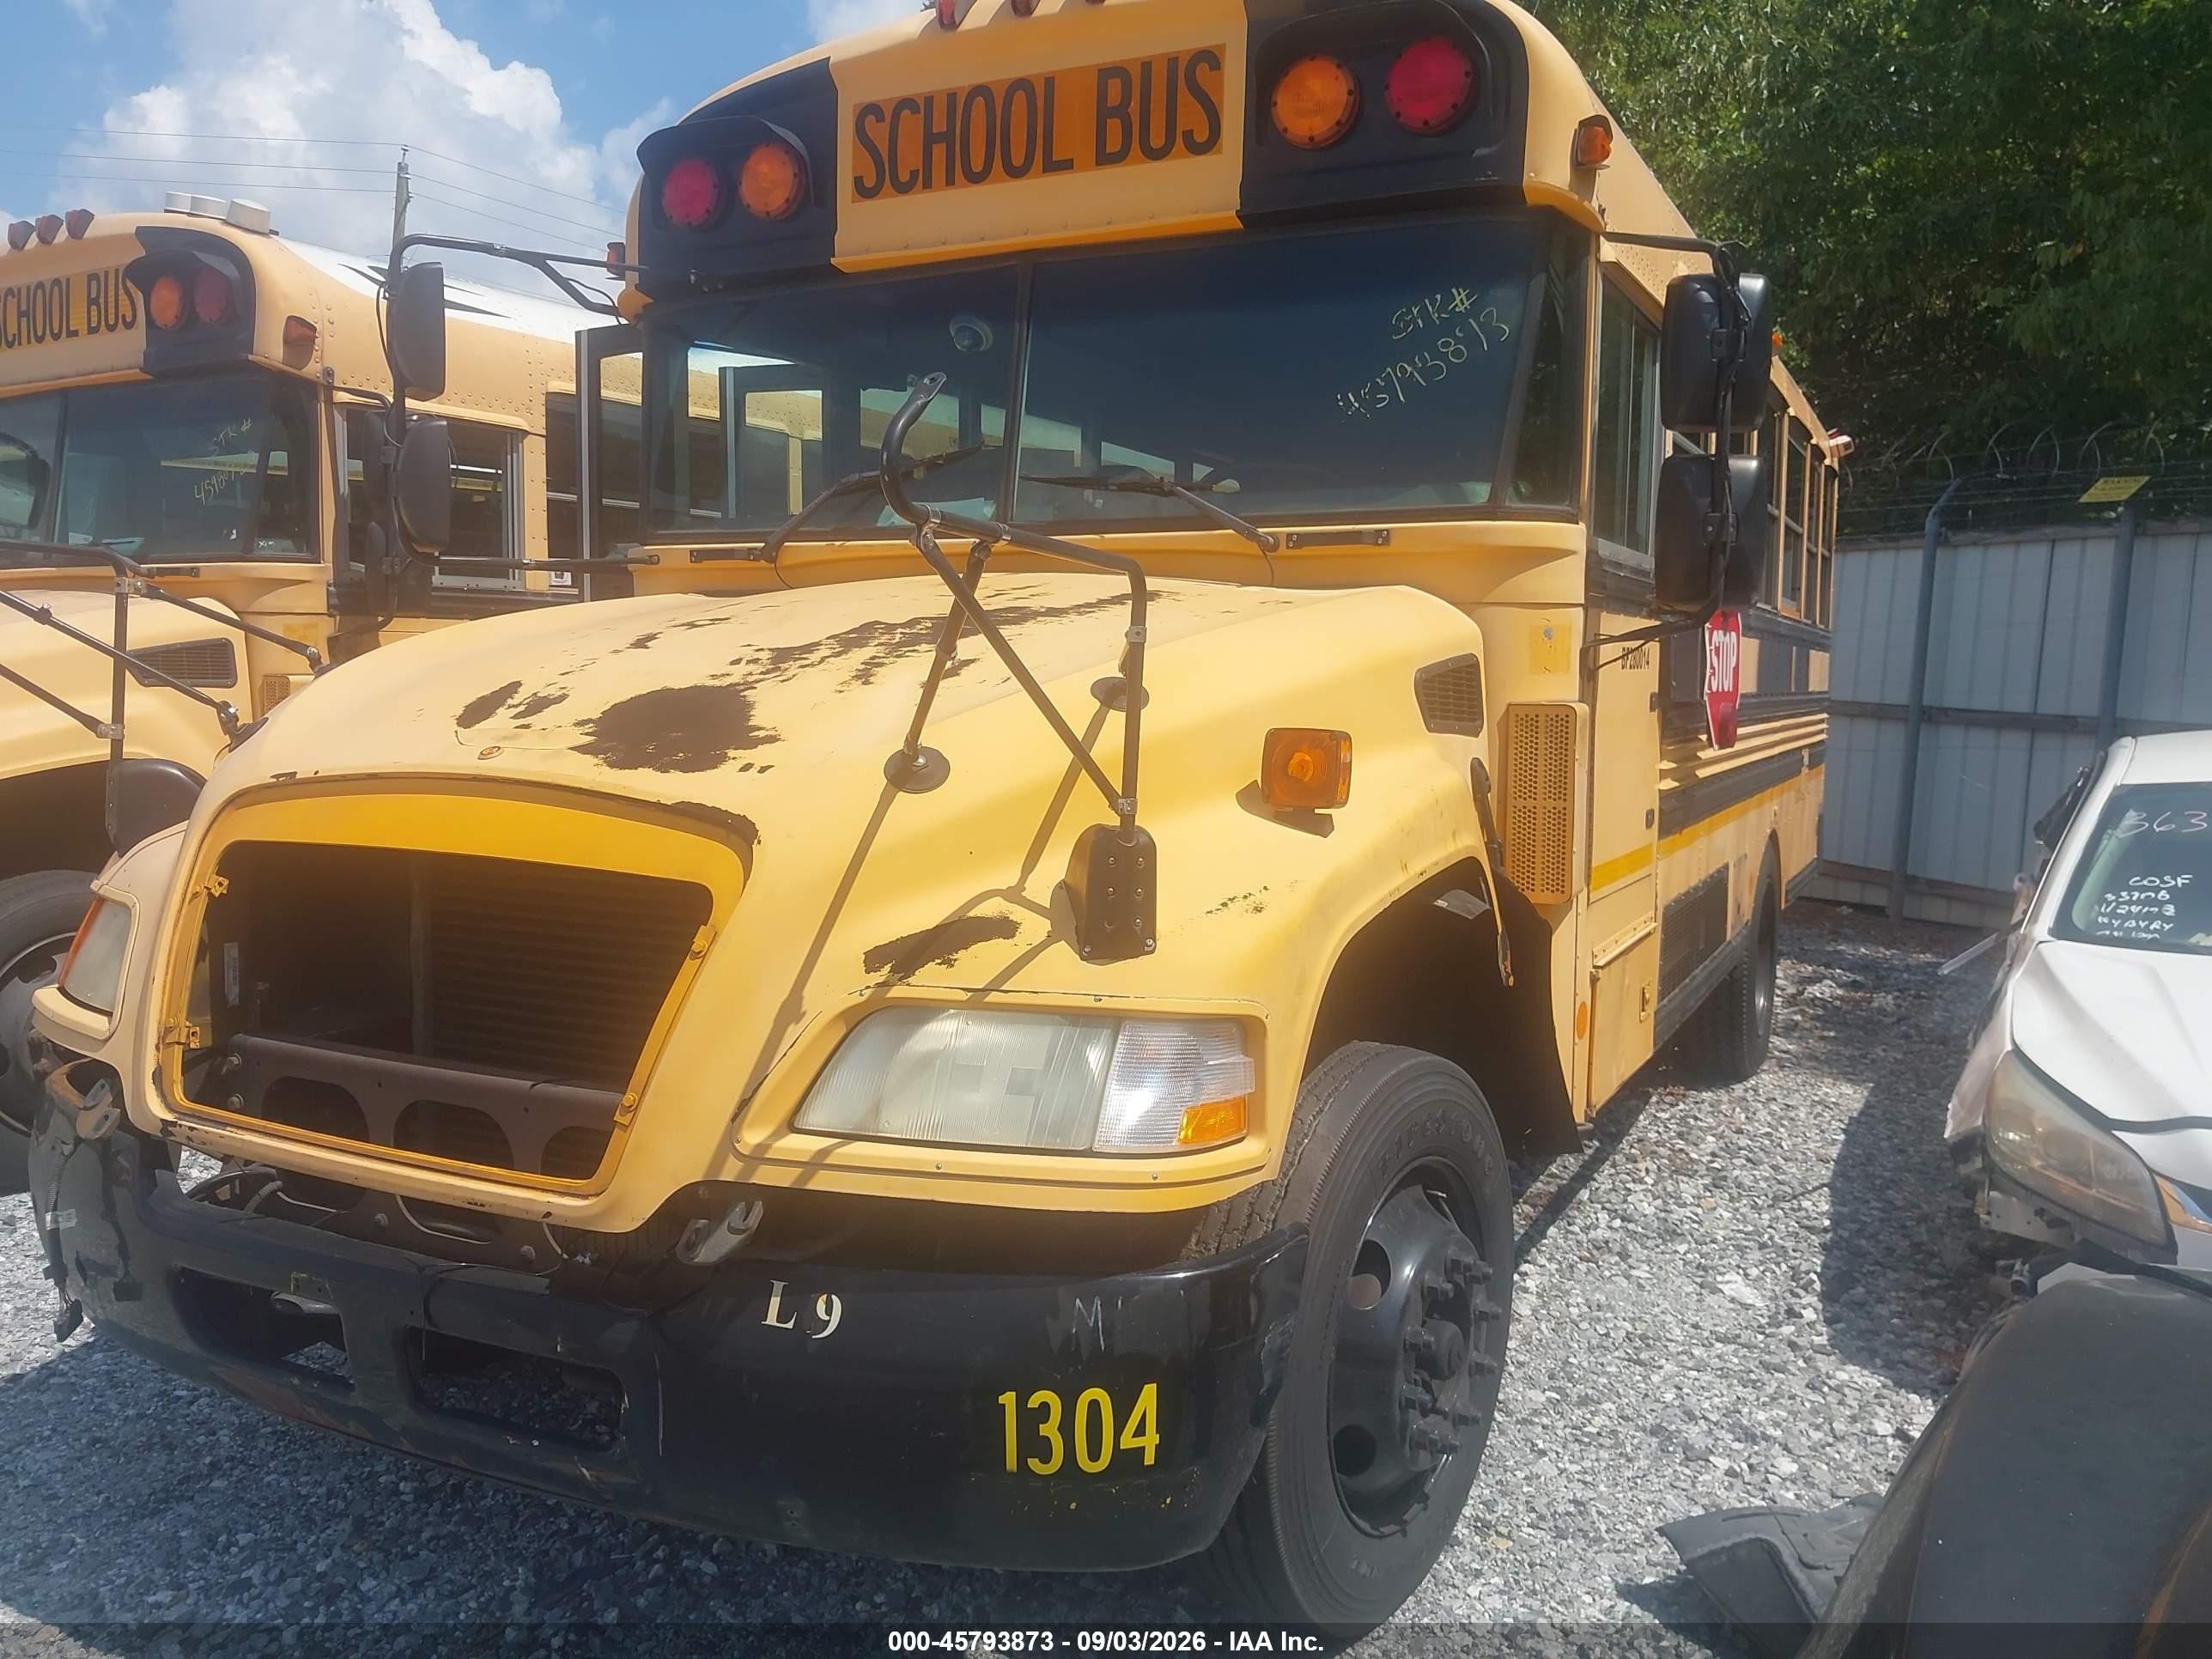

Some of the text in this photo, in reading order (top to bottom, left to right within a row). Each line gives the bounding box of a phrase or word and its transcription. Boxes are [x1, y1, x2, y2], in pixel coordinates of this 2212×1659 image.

[854, 49, 1222, 198] SCHOOL BUS
[0, 267, 137, 349] CHOOL BUS
[1711, 629, 1737, 693] STOP
[998, 1382, 1159, 1476] 1304
